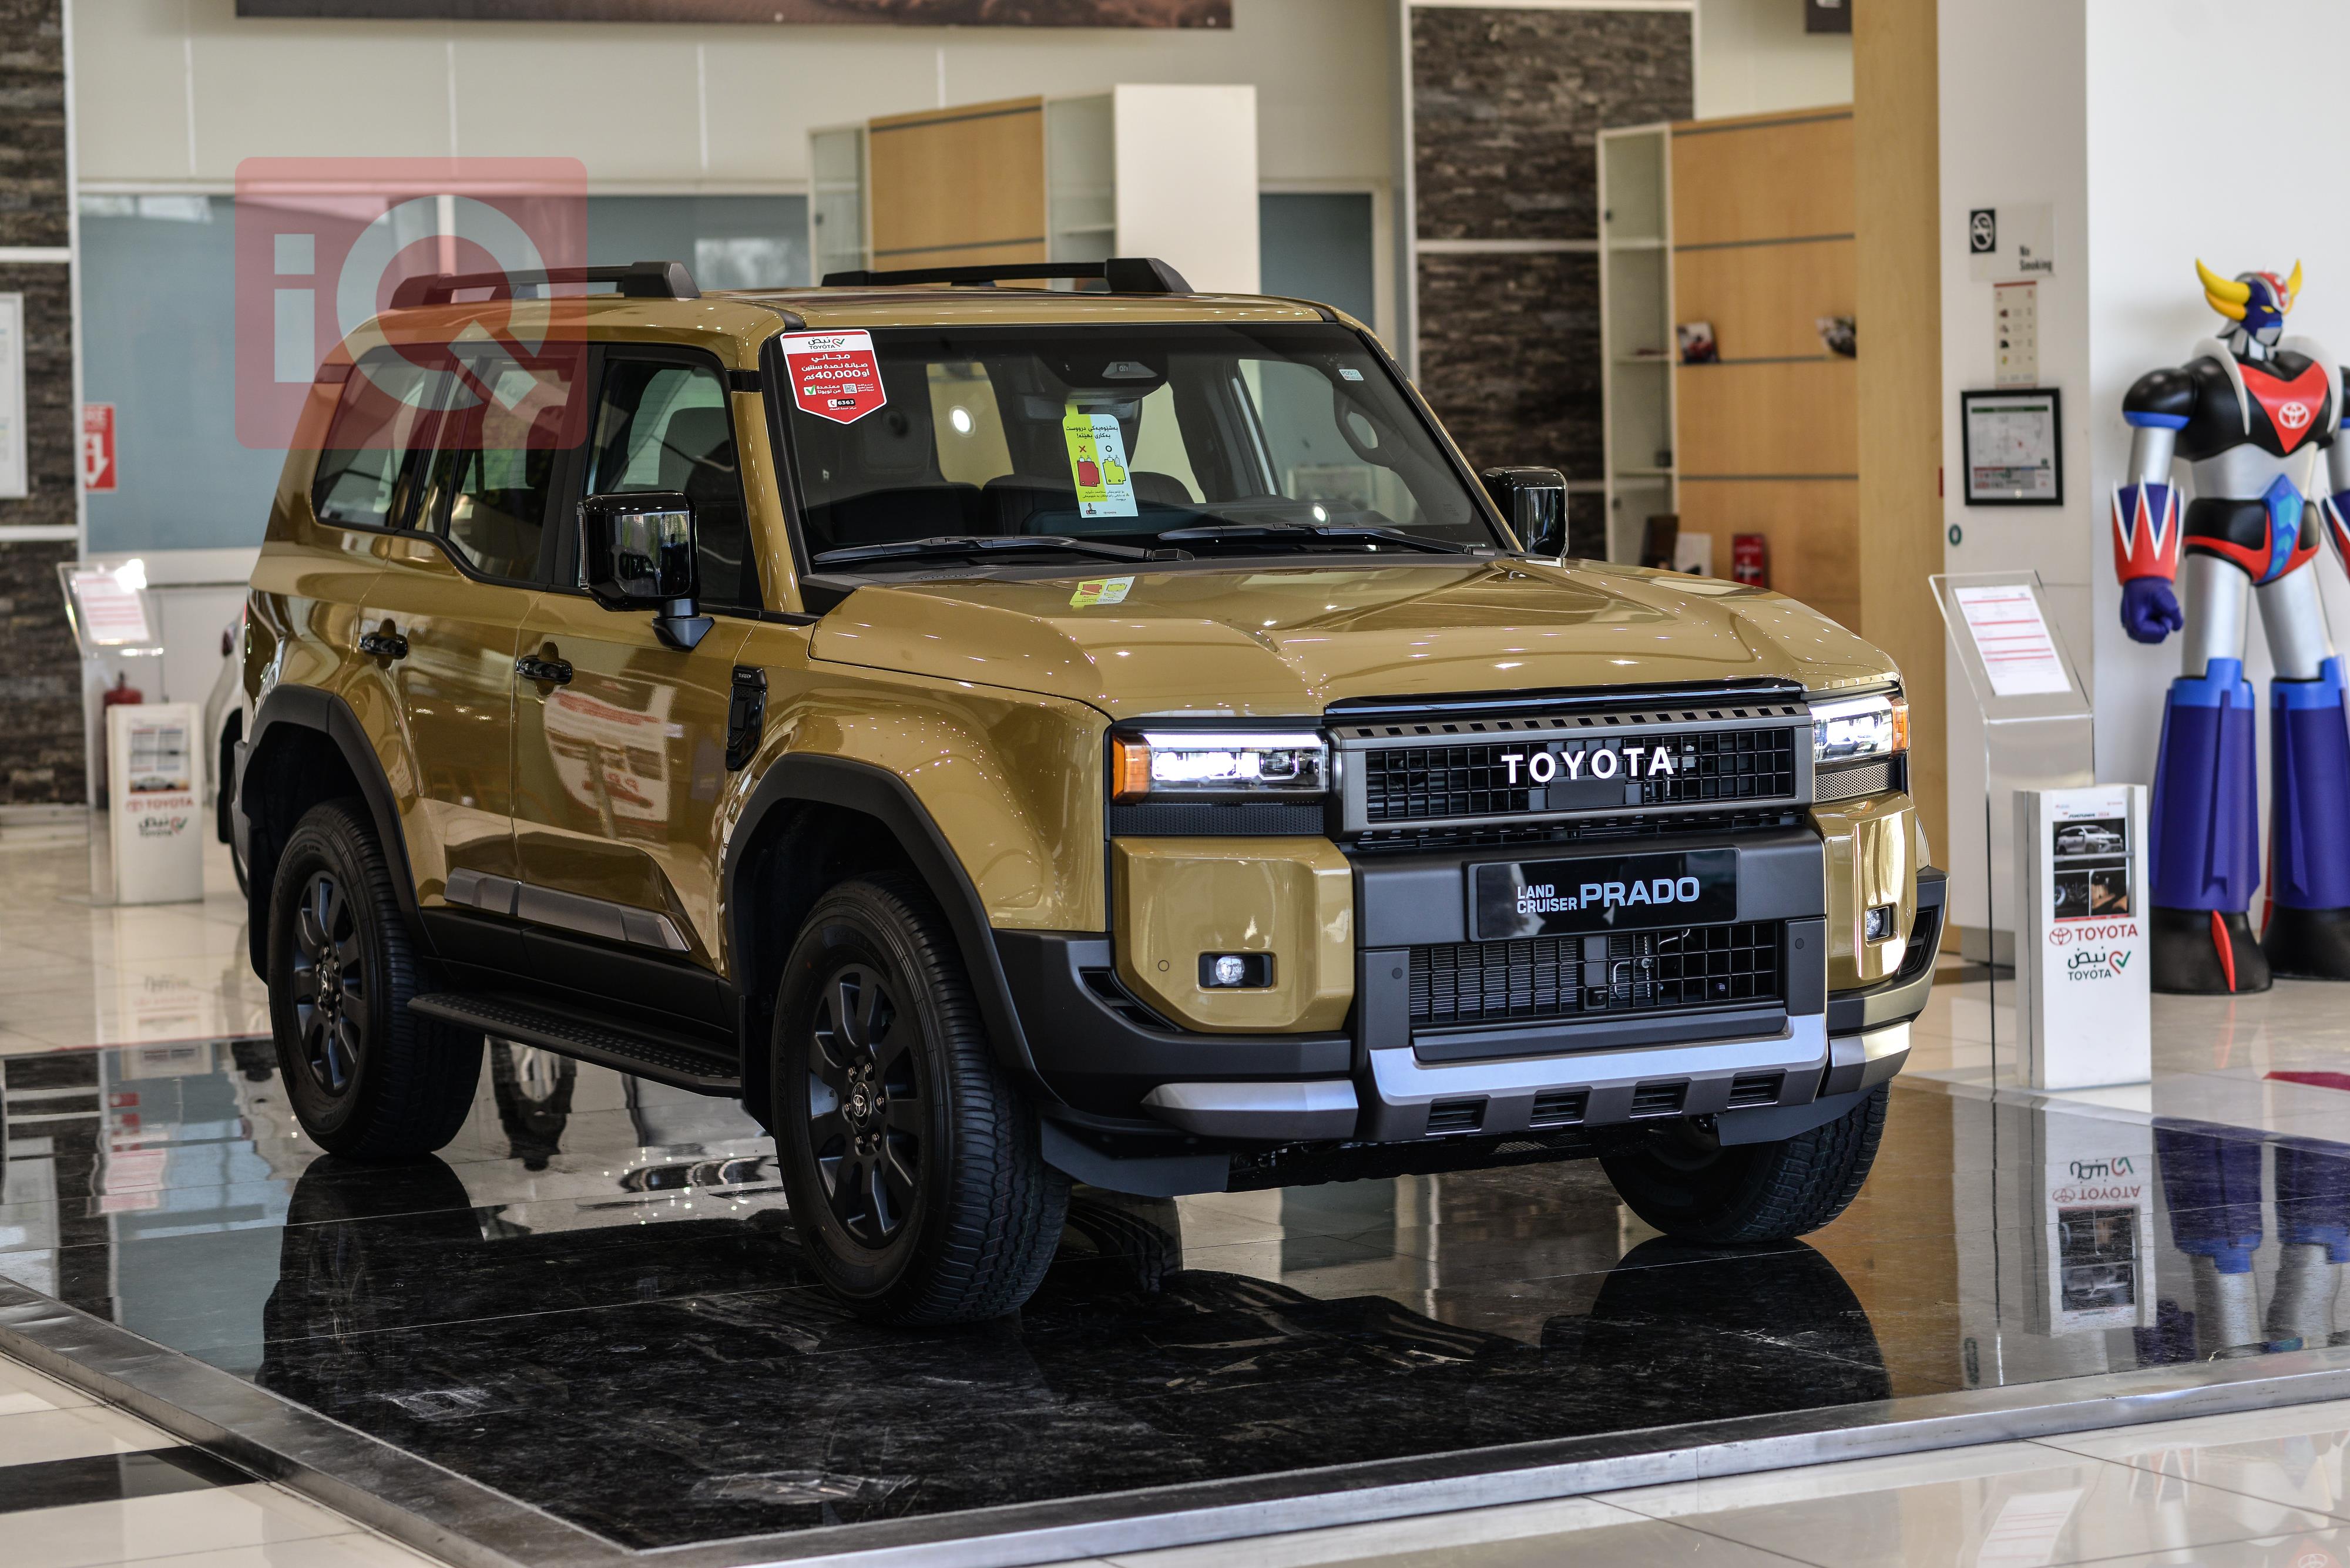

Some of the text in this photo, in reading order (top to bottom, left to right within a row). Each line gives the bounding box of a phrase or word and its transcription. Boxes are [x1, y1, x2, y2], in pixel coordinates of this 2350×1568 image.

[2020, 246, 2030, 256] No
[2020, 259, 2052, 273] Smoking
[808, 337, 831, 345] نبض
[811, 354, 851, 362] مجاني
[1500, 746, 1674, 784] TOYOTA
[1517, 884, 1555, 899] LAND
[1517, 877, 1700, 914] CRUISER PRADO
[2074, 924, 2138, 941] TOYOTA
[2067, 946, 2106, 969] نبض
[2067, 969, 2112, 981] TOYOTA
